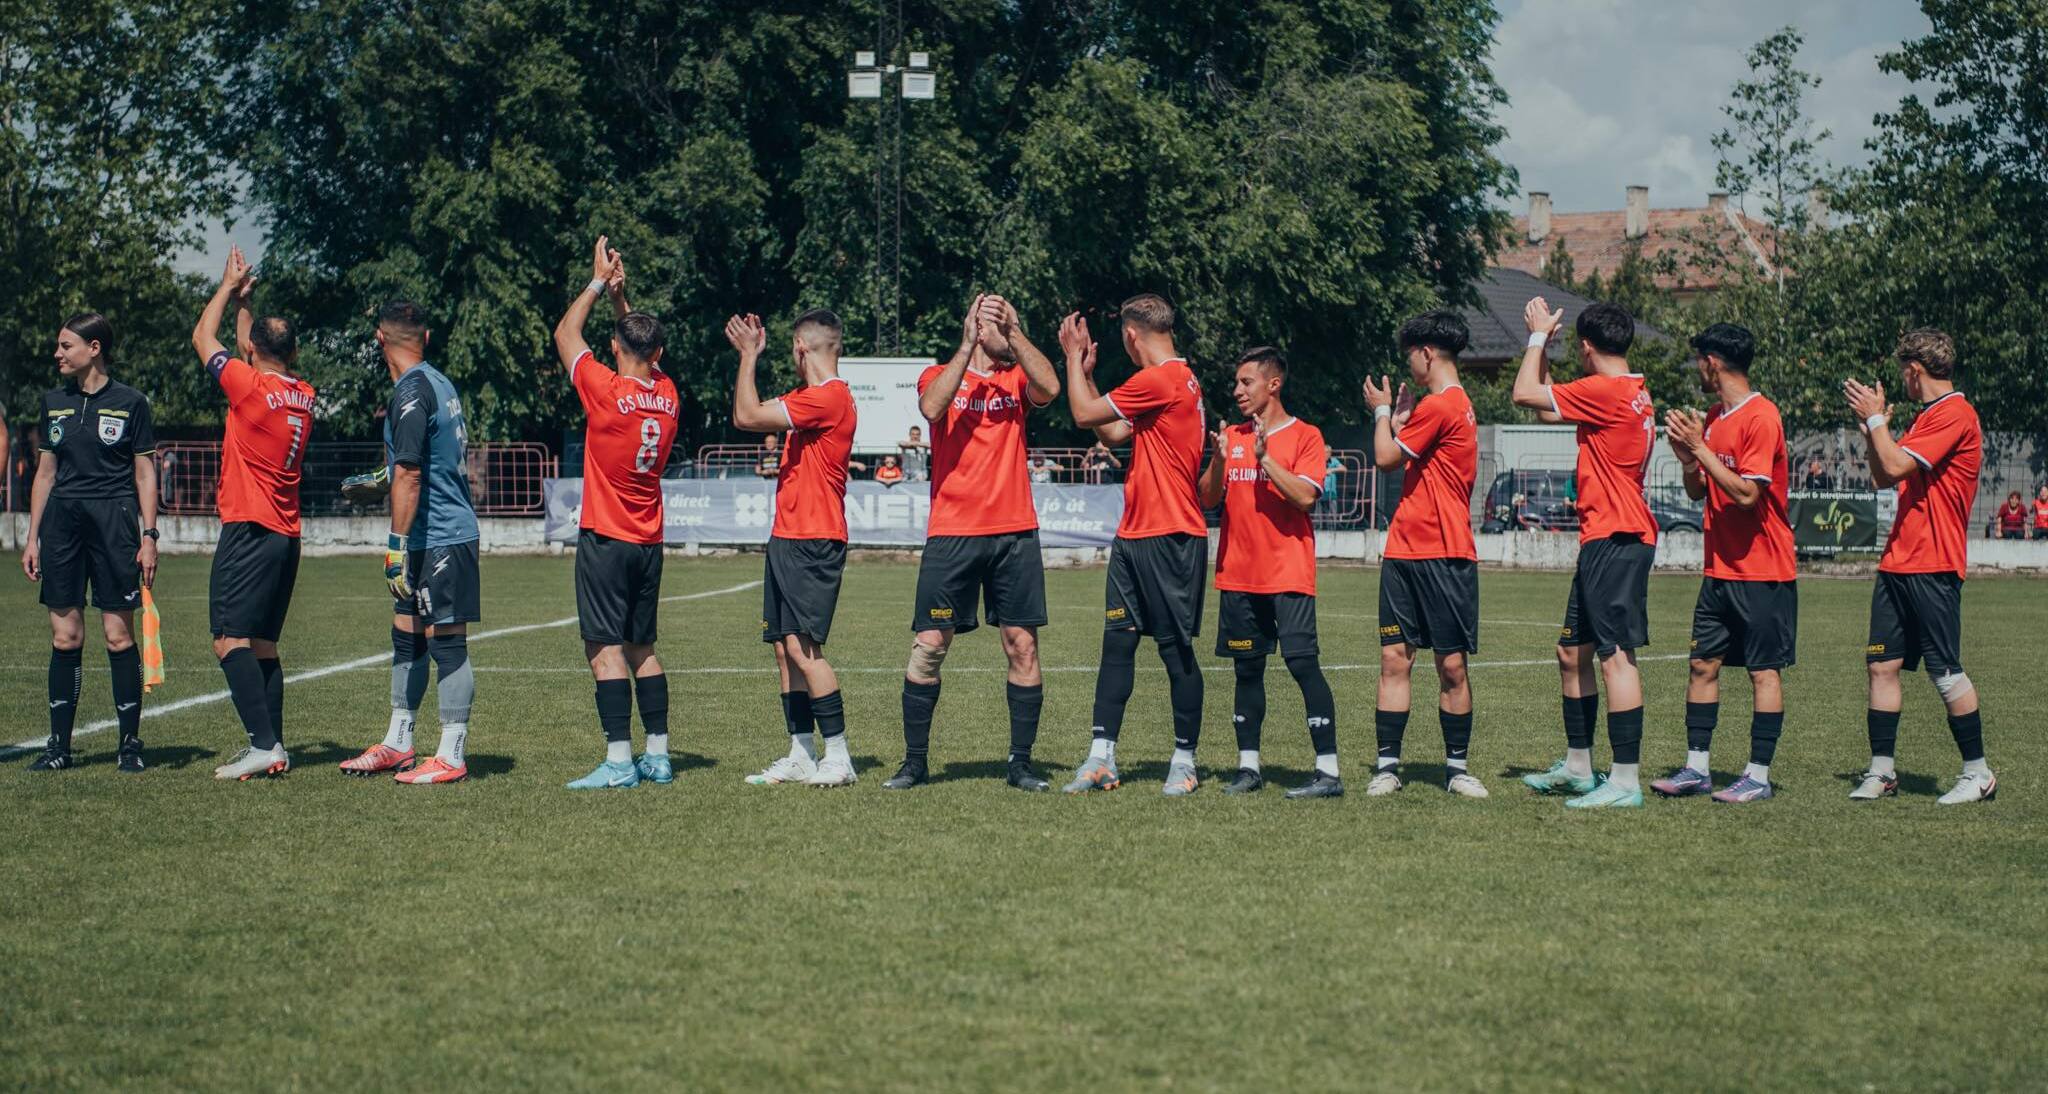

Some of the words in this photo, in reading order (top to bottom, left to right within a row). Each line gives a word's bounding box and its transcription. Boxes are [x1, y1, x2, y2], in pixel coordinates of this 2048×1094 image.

[266, 391, 284, 410] CS
[284, 390, 314, 414] UNIRE
[617, 394, 636, 414] CS
[636, 392, 676, 418] UNIREA
[954, 396, 968, 410] SC
[286, 415, 303, 470] 7
[635, 417, 661, 474] 8
[1228, 467, 1239, 481] SC
[669, 493, 711, 509] direct
[1040, 497, 1061, 516] jó
[1065, 497, 1087, 514] út
[664, 514, 704, 527] ucces
[1040, 516, 1104, 532] kerhez
